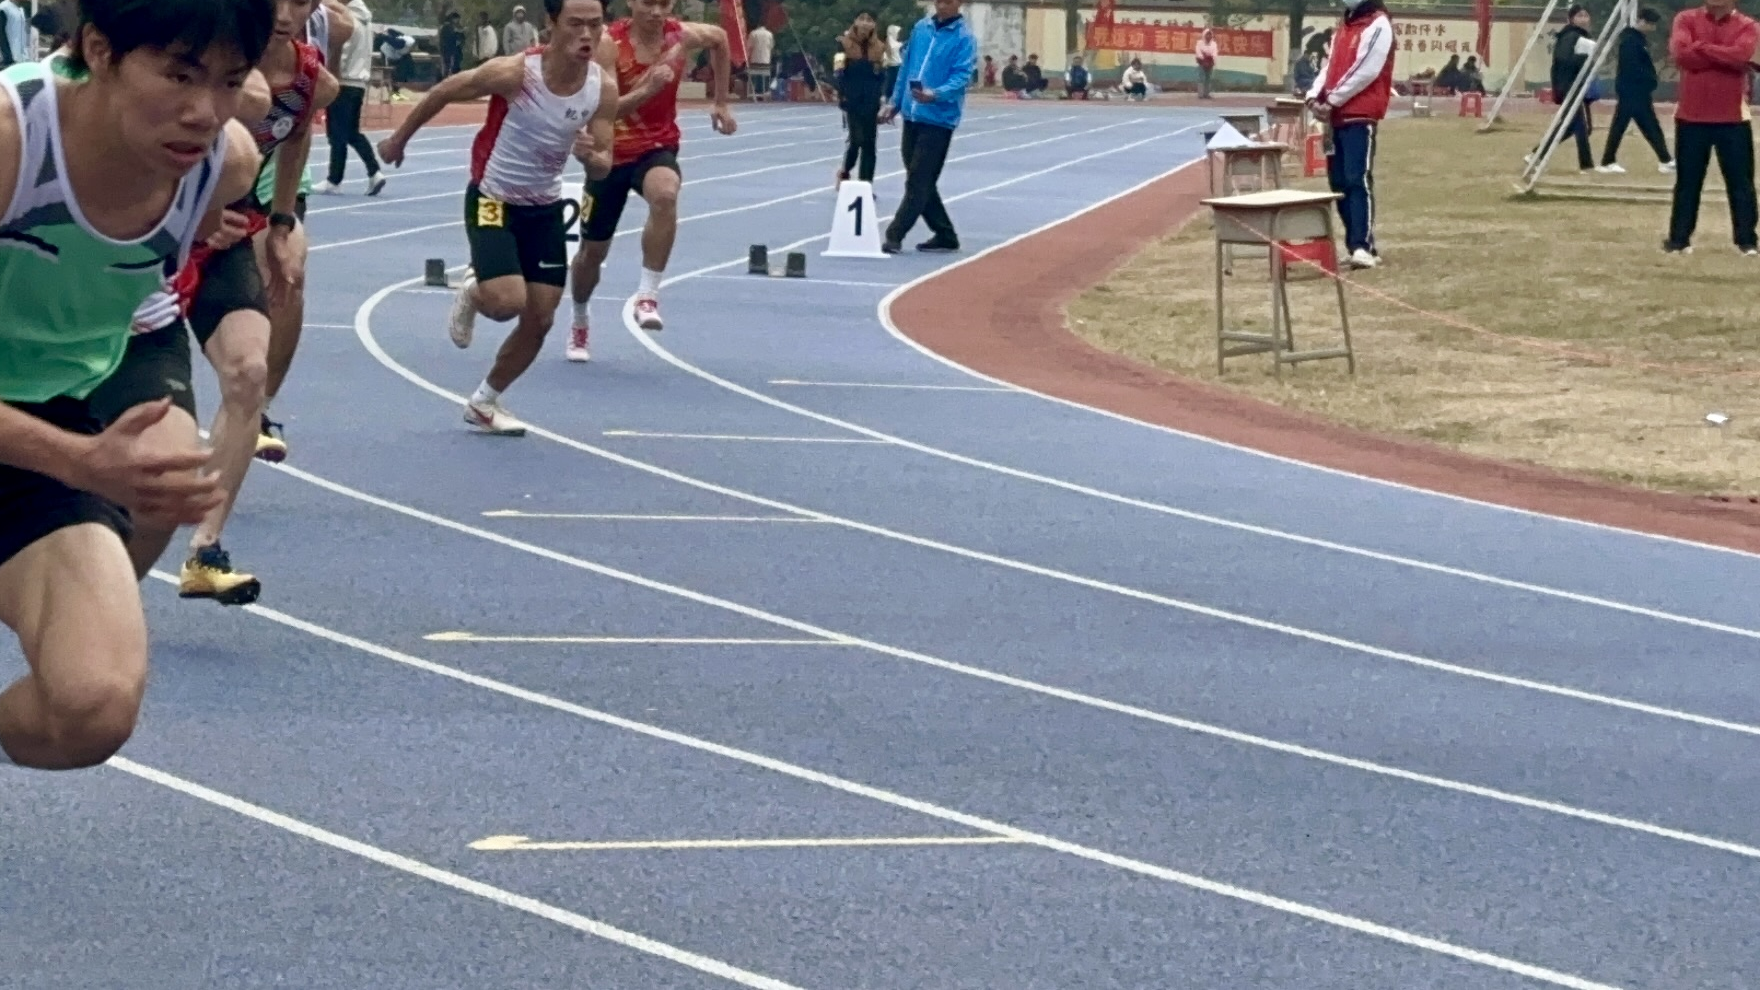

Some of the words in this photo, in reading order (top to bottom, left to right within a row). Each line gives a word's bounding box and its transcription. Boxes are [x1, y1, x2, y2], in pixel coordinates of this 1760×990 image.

[482, 201, 498, 222] 3
[561, 198, 581, 242] 2
[848, 196, 862, 236] 1
